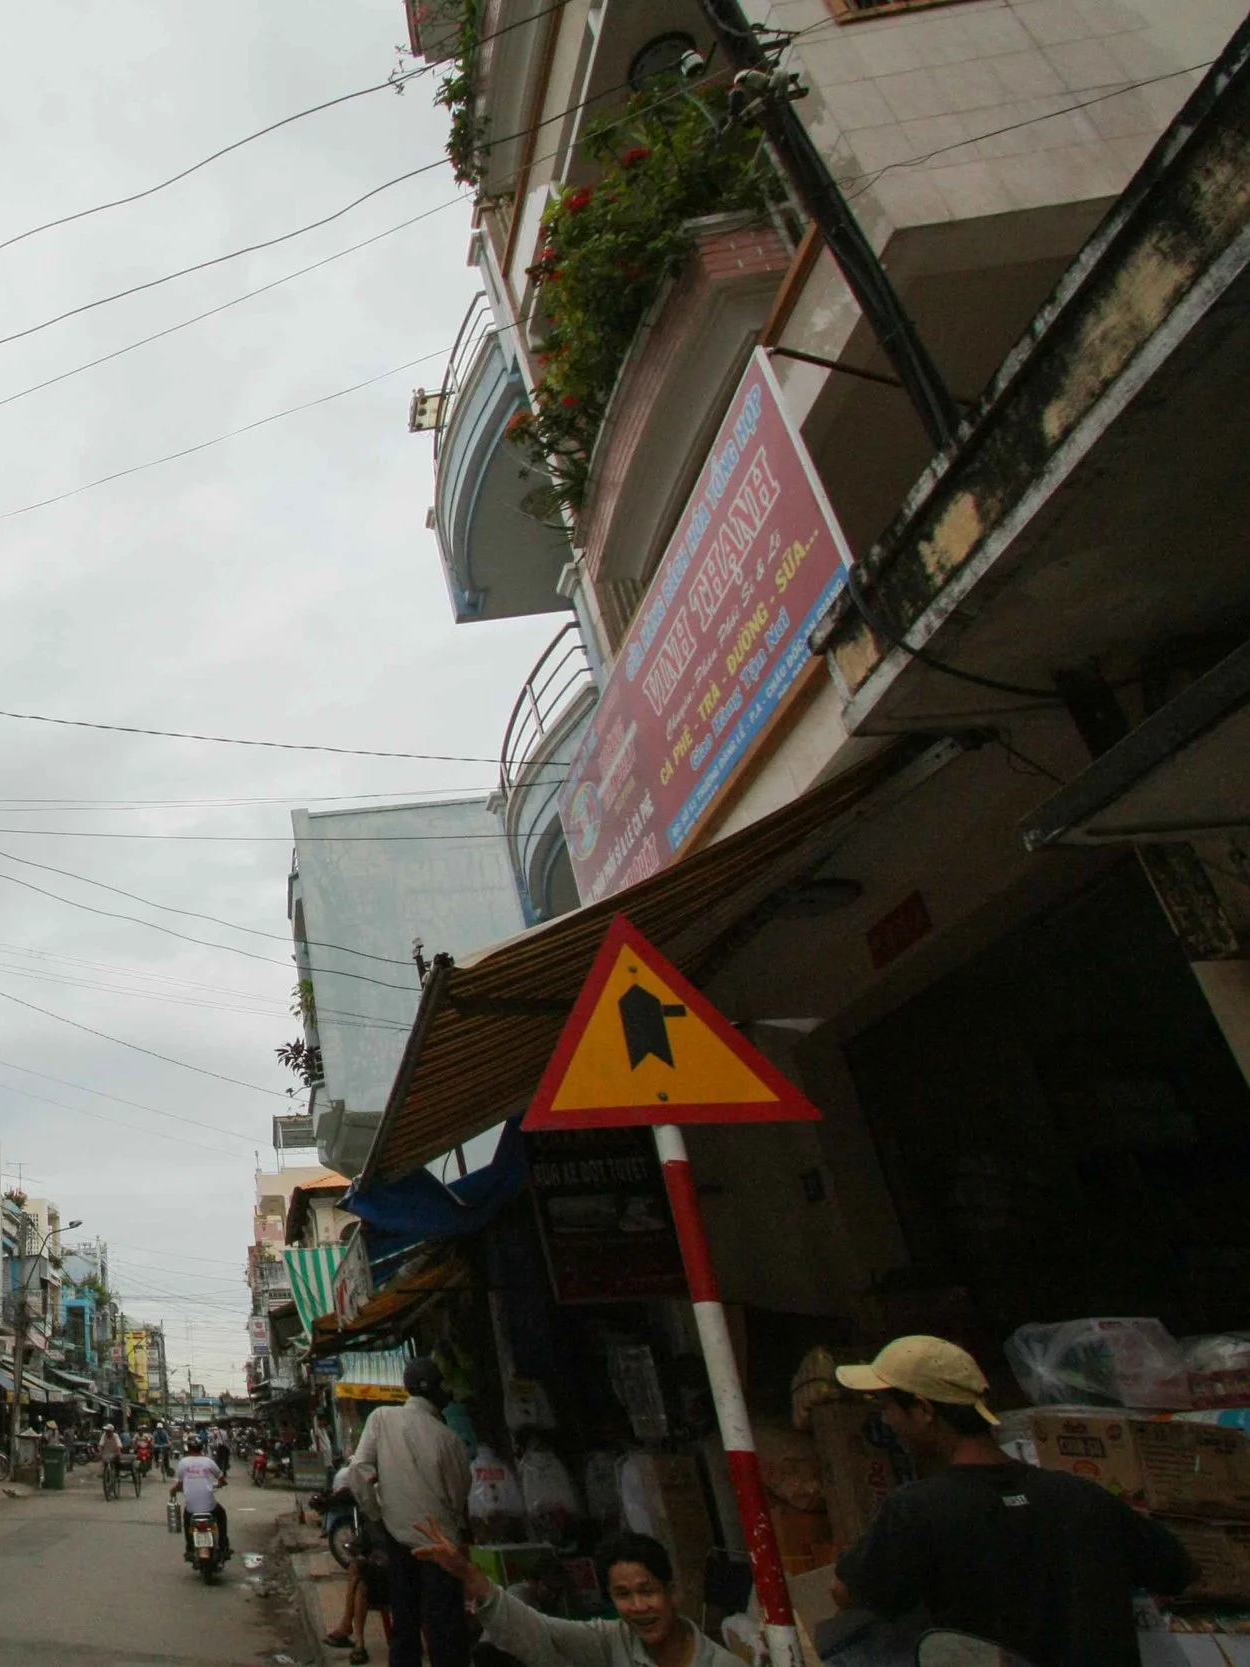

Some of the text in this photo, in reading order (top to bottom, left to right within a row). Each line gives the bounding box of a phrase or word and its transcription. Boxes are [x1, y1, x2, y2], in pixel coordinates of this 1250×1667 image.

[704, 439, 739, 509] TỔNG
[732, 382, 761, 451] HỢP
[688, 448, 779, 630] THẠNH
[659, 758, 674, 785] CÀ
[671, 724, 693, 765] PHÊ
[696, 680, 721, 721] TRÀ
